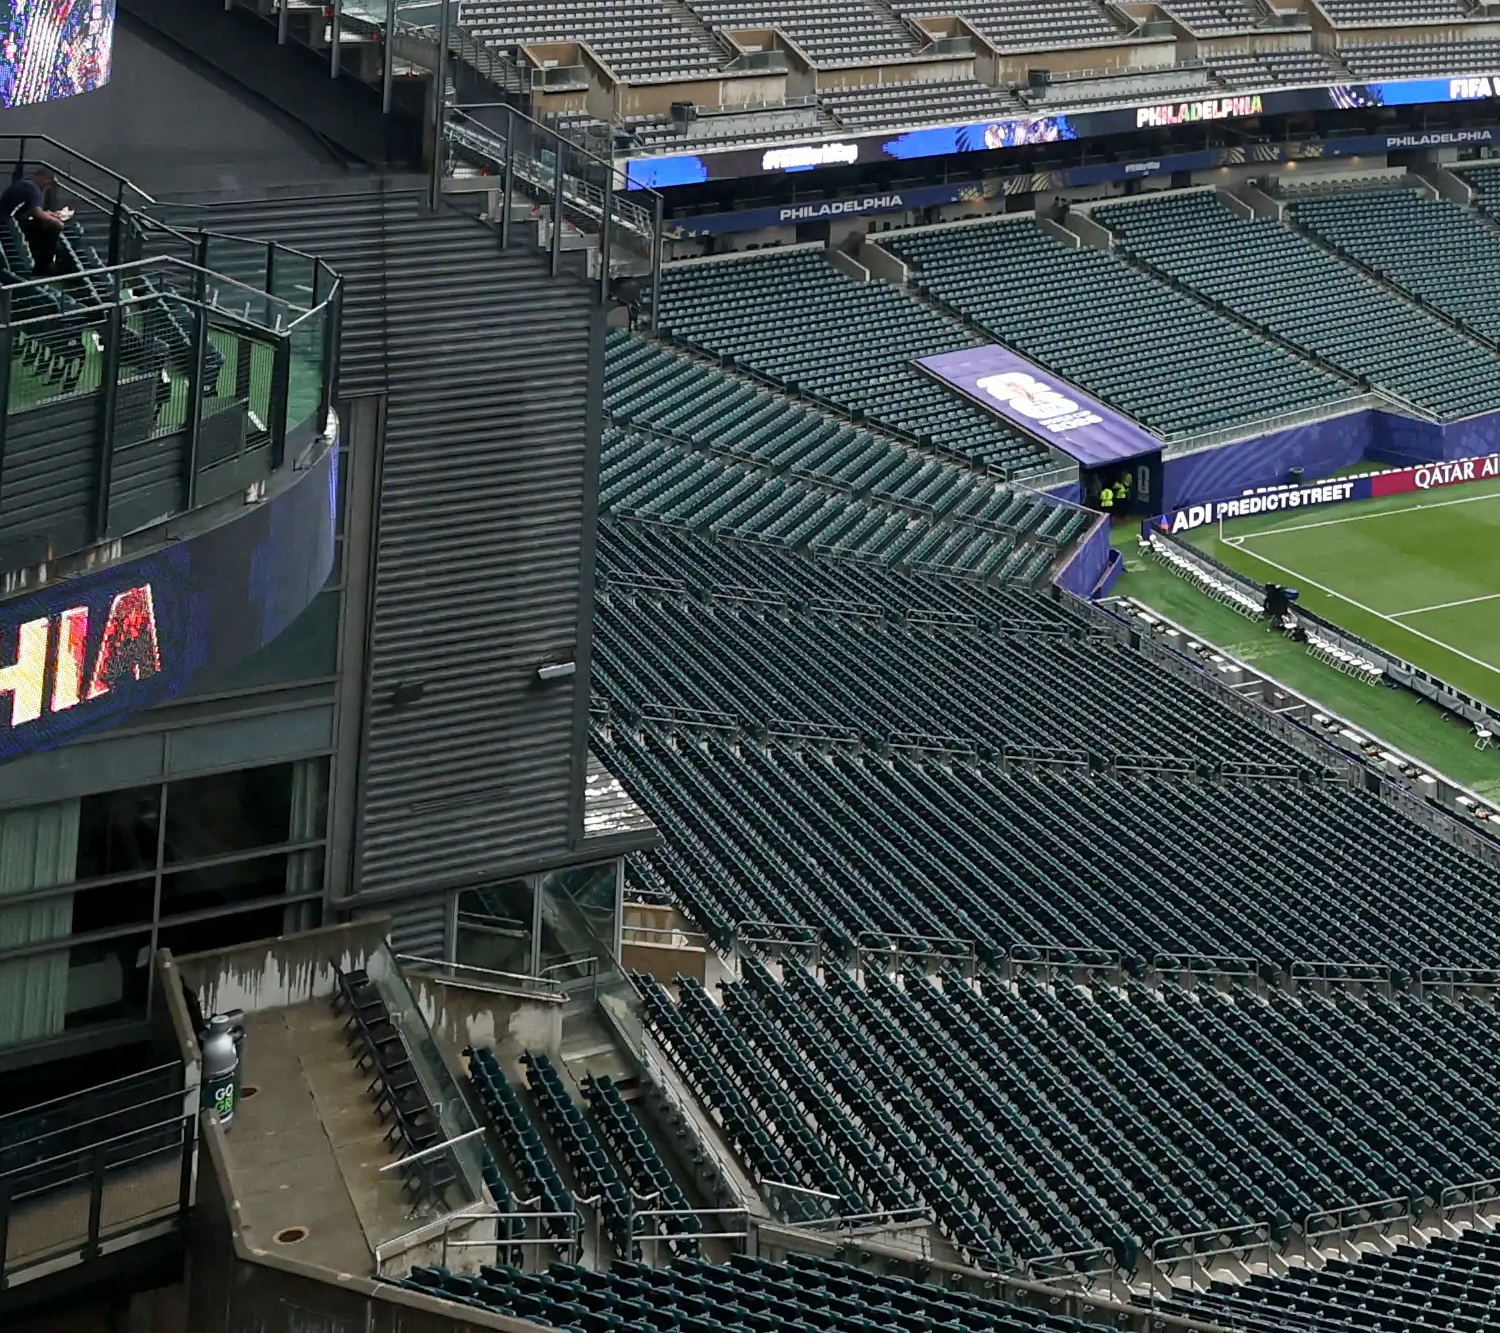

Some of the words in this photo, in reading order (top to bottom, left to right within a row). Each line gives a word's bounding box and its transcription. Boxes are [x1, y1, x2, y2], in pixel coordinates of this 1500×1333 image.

[1450, 79, 1492, 98] FIFA
[1137, 95, 1262, 128] PHILADELPHIA
[1386, 130, 1492, 147] PHILADELPHIA
[780, 195, 903, 221] PHILADELPHIA
[1415, 463, 1476, 489] QATAR
[1172, 501, 1213, 534] ADI
[1217, 483, 1354, 519] PREDICTSTREET
[215, 1083, 234, 1101] GO
